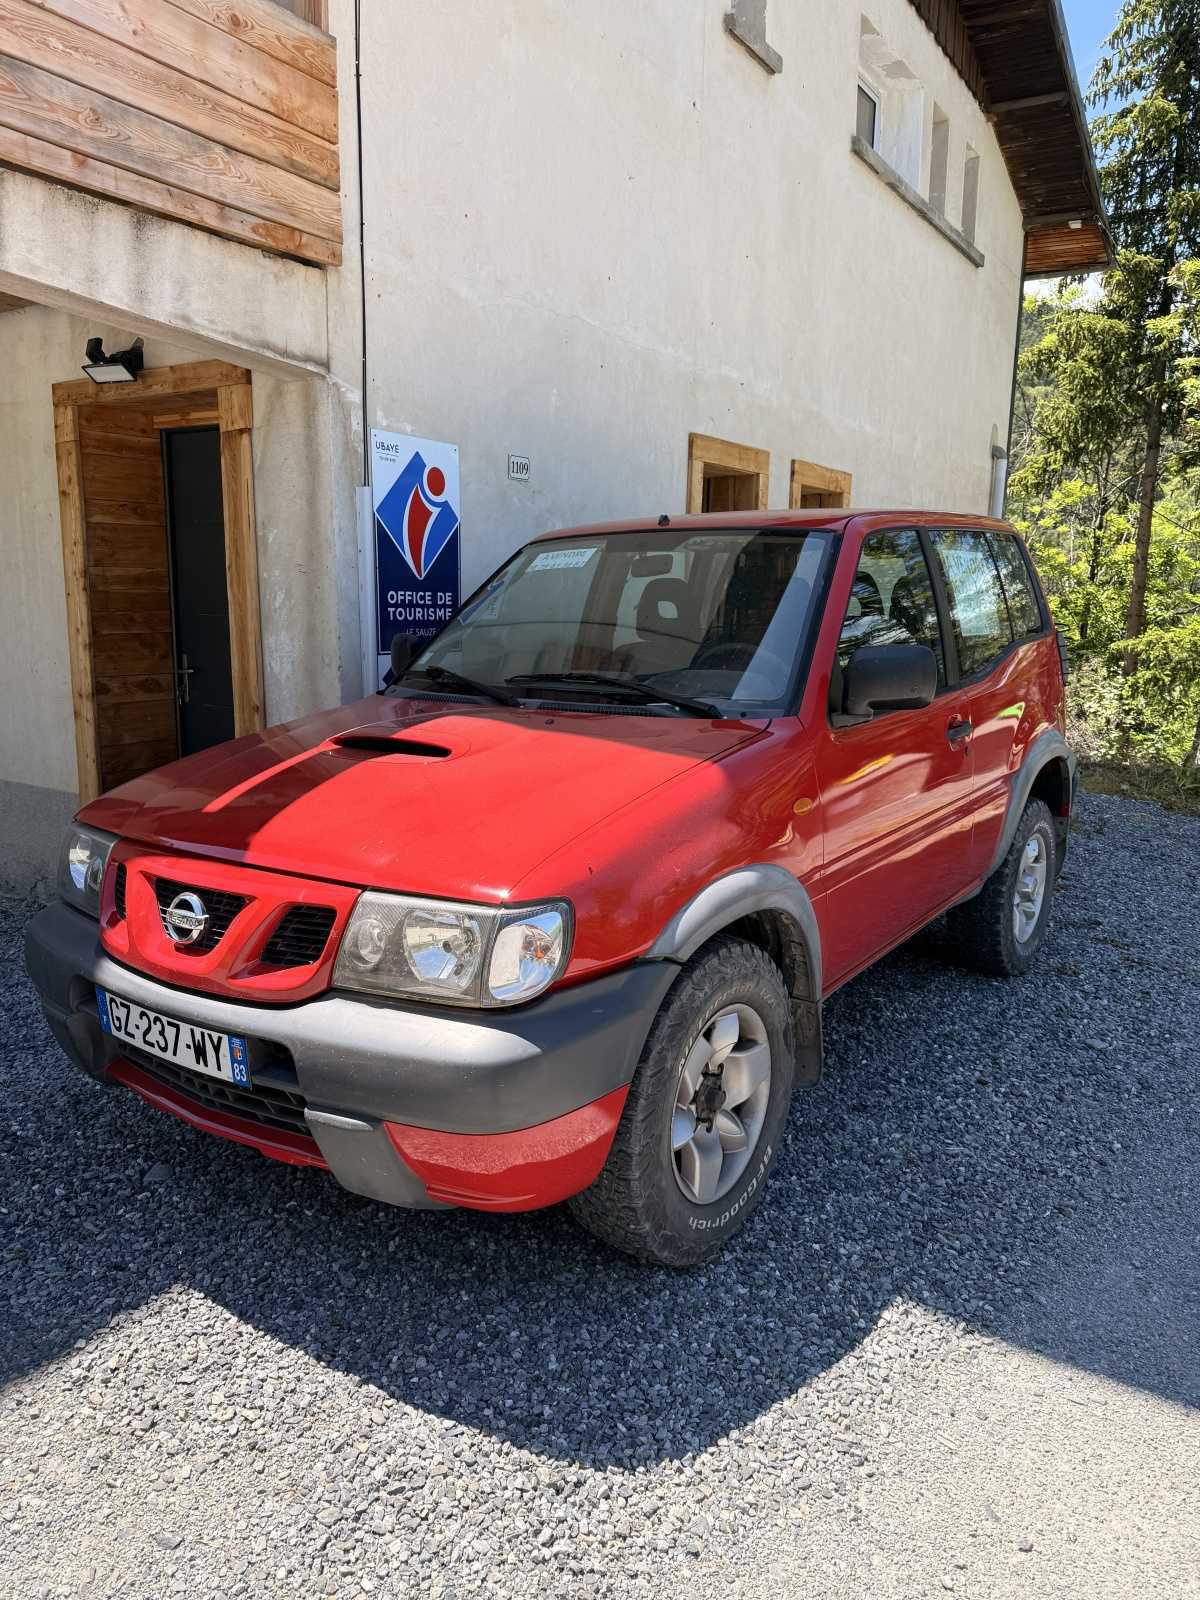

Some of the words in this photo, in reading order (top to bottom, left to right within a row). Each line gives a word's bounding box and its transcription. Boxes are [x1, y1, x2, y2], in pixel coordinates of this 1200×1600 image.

[375, 440, 400, 454] UBAYE
[511, 460, 529, 475] 1109
[387, 590, 433, 605] OFFICE
[437, 592, 453, 605] DE
[387, 607, 453, 621] TOURISME
[108, 997, 223, 1072] GZ-237-WY
[233, 1063, 247, 1082] 83
[688, 1144, 772, 1232] BFGoodrich
